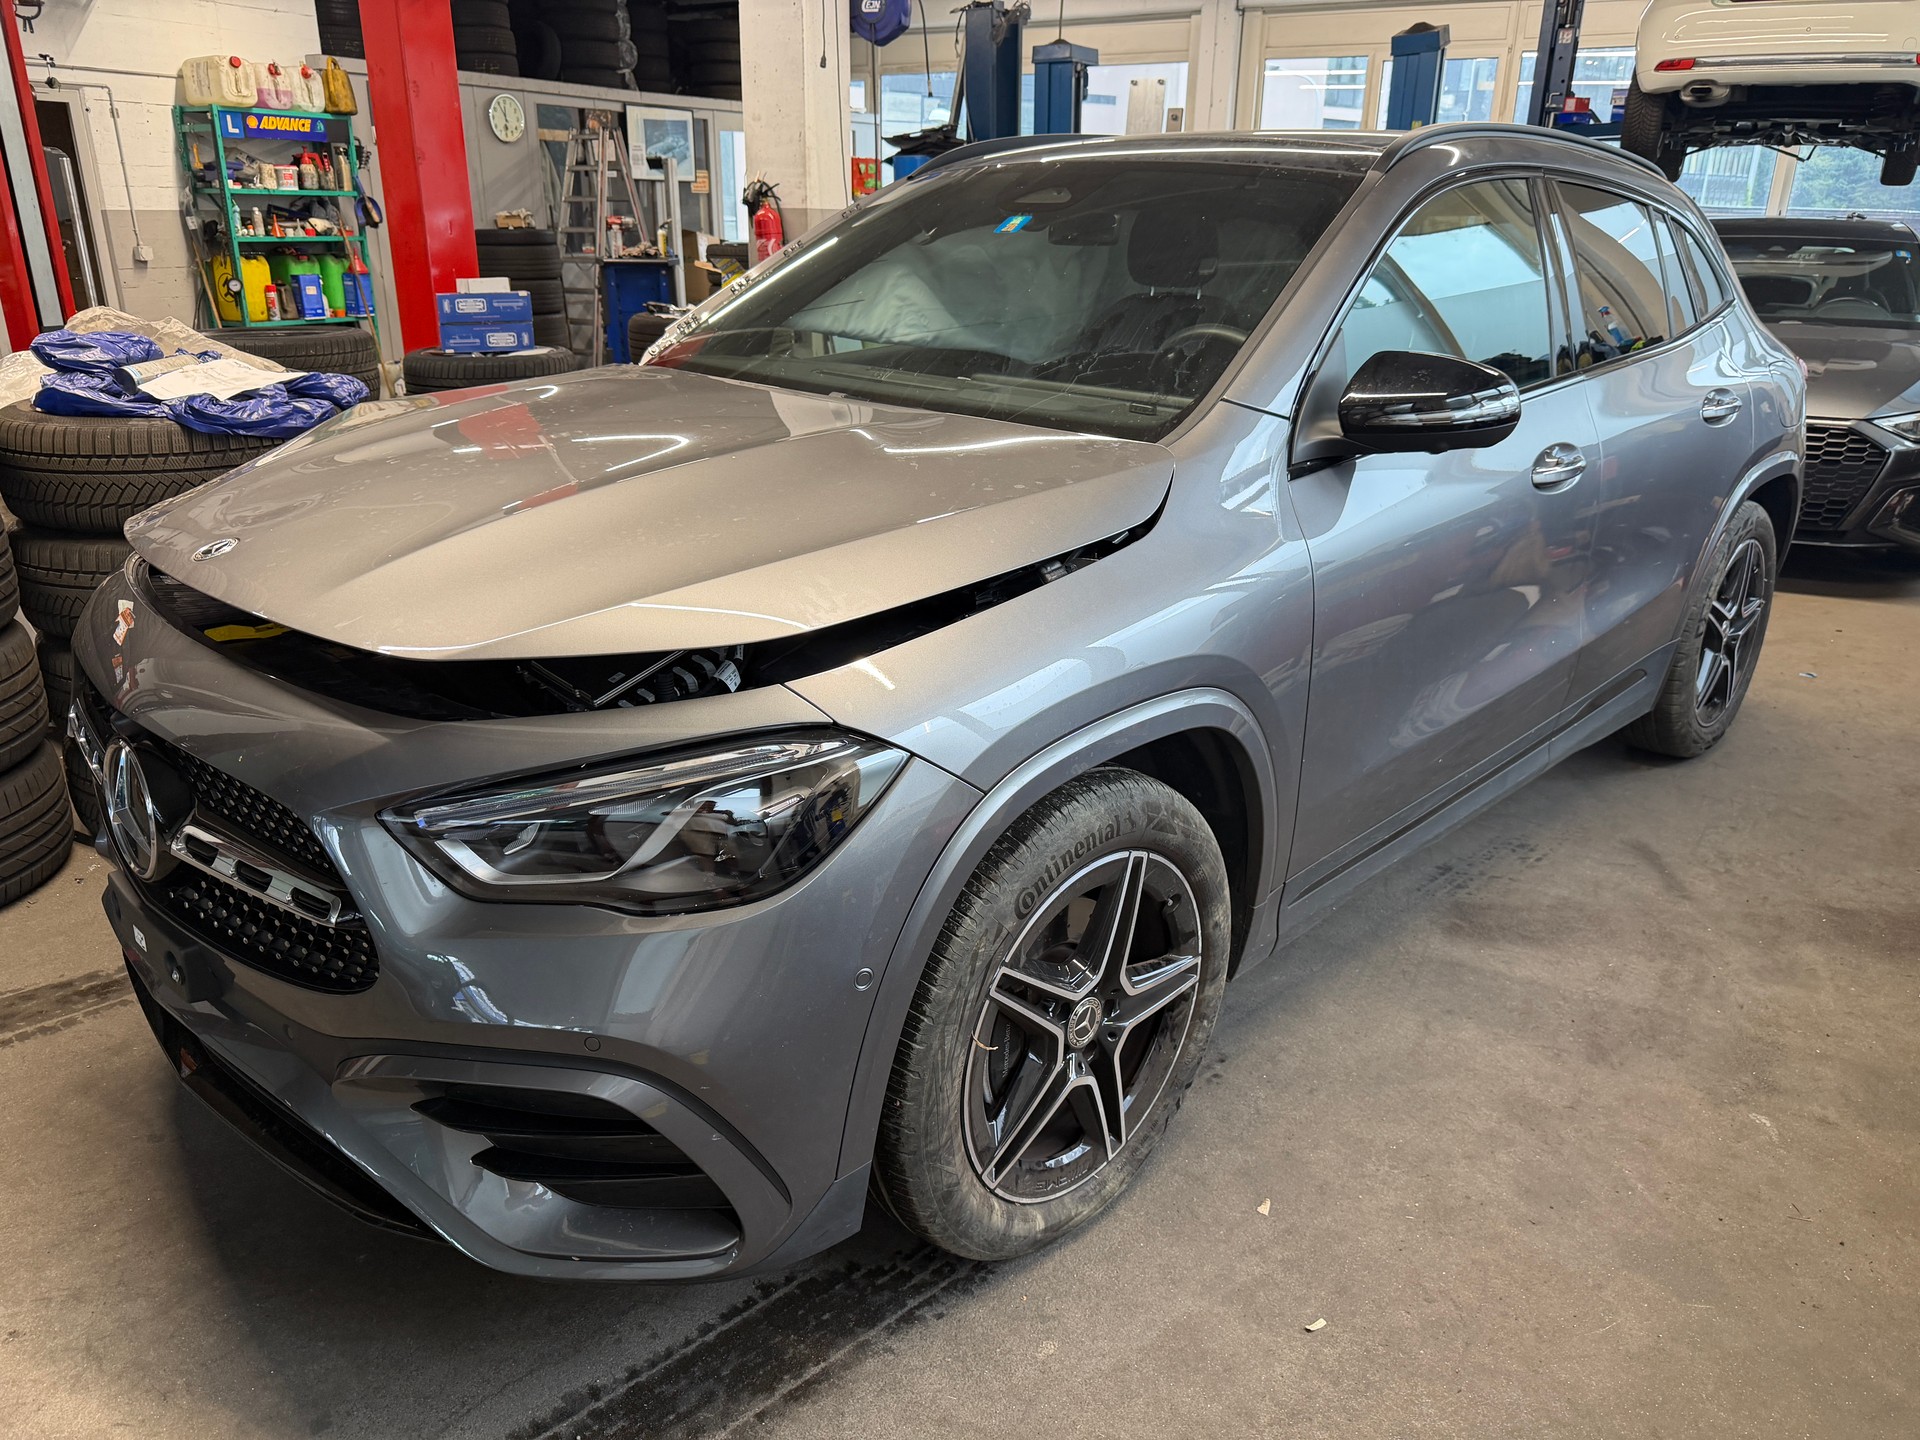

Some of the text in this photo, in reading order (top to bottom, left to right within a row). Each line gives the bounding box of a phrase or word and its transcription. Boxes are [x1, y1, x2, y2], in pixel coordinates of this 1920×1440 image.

[226, 115, 239, 133] L
[259, 116, 311, 132] ADVANCE
[1014, 814, 1122, 920] Continental
